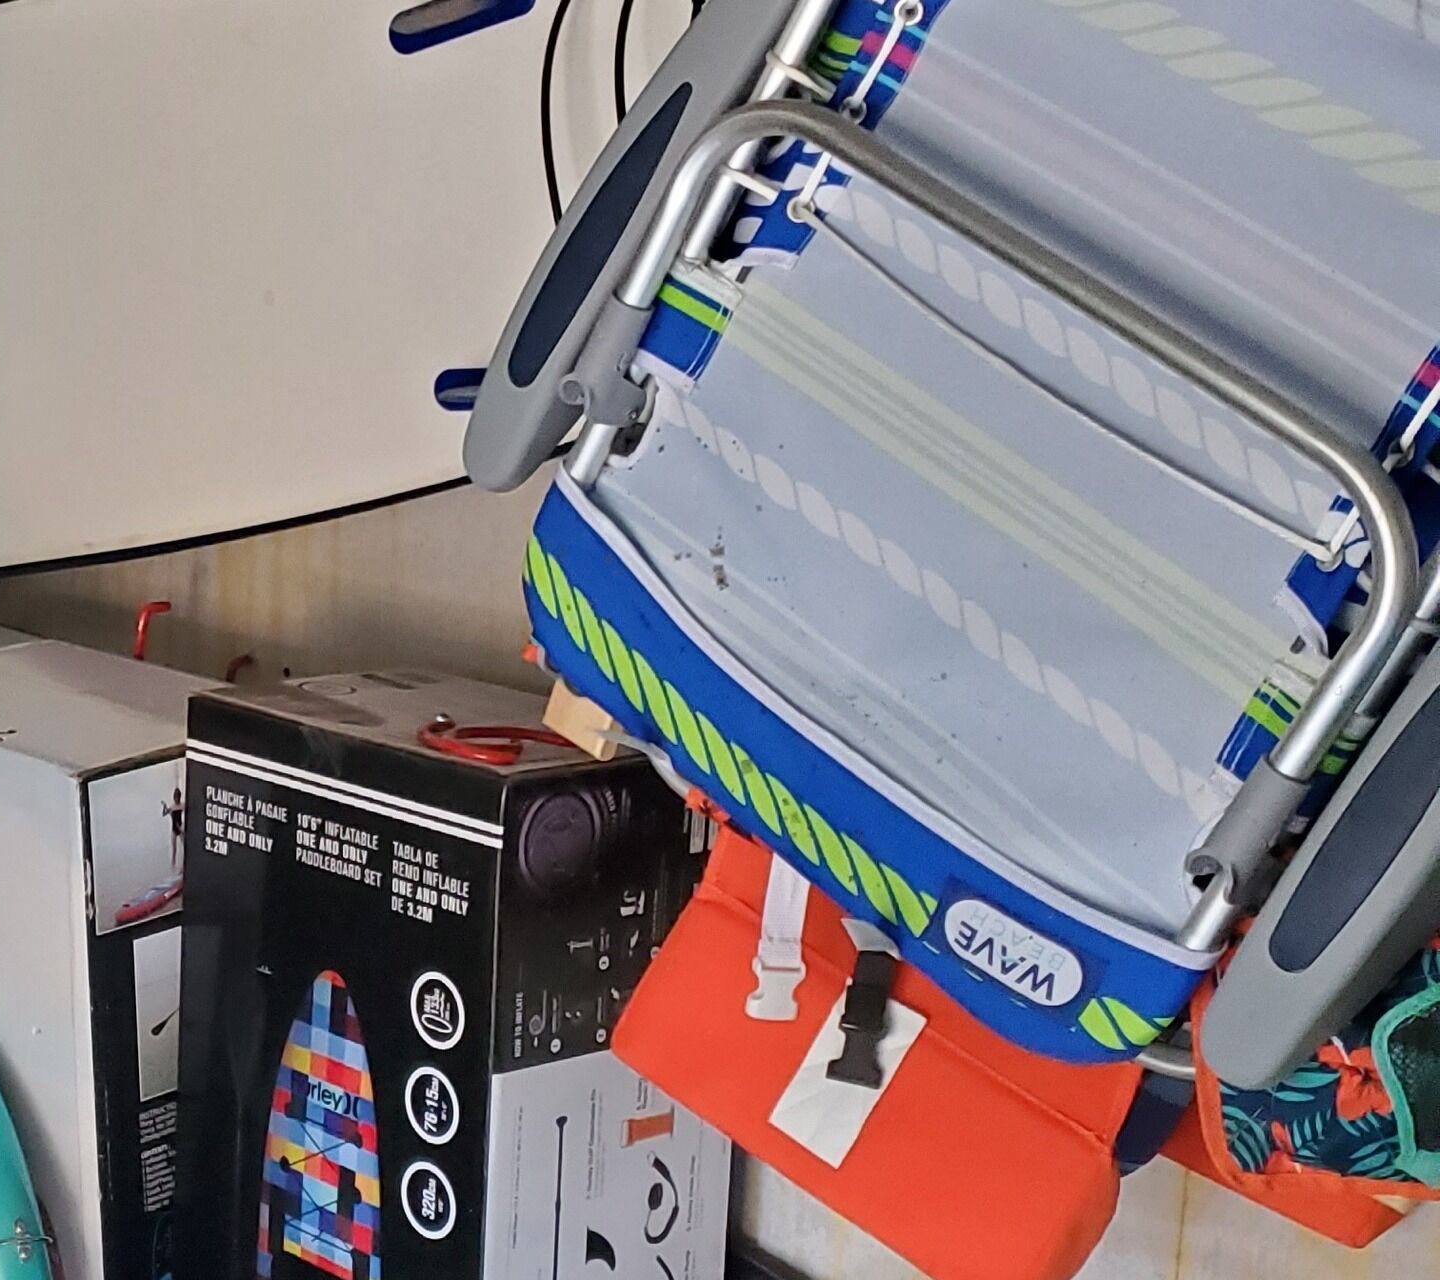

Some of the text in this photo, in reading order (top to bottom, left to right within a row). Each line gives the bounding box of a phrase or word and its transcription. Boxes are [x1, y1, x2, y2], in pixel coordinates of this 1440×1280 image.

[206, 785, 245, 810] PLANCHE
[255, 799, 288, 823] PAGAIE
[206, 802, 255, 830] GONFLABLE
[205, 819, 273, 853] ONE AND ONLY
[205, 836, 228, 856] 3.2M
[296, 829, 368, 865] ONE AND ONLY
[324, 820, 379, 850] INFLATABLE
[296, 846, 382, 888] PADDLEBOARD SET
[392, 841, 439, 869] TABLA DE
[392, 859, 470, 898] REMO INFLABLE
[391, 895, 433, 923] DE 3.2M
[392, 877, 469, 917] ONE AND ONLY
[969, 907, 1067, 971] BEACH
[953, 920, 1056, 1003] WAVE
[304, 1081, 344, 1111] rley
